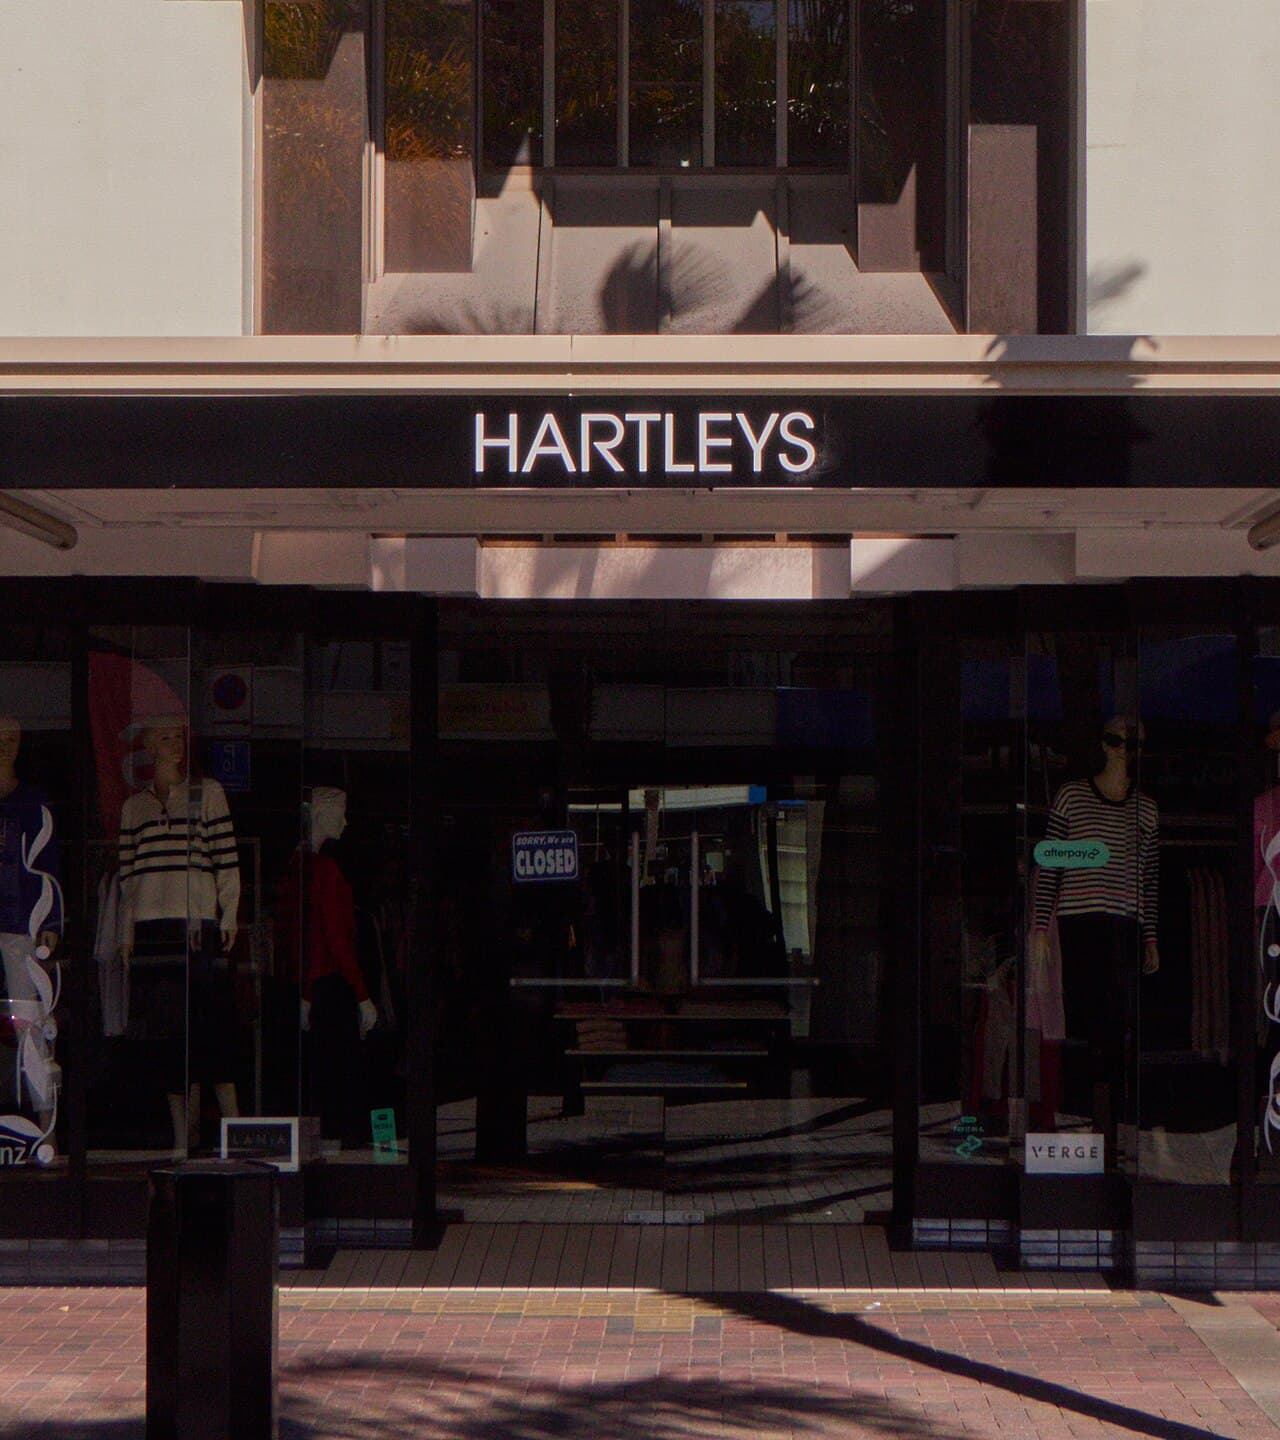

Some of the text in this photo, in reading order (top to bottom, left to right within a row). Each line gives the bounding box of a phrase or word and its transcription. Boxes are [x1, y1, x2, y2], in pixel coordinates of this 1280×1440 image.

[474, 412, 816, 472] HARTLEYS
[517, 848, 575, 875] CLOSED
[1044, 847, 1087, 859] afterpay
[1032, 1146, 1099, 1158] VERGE
